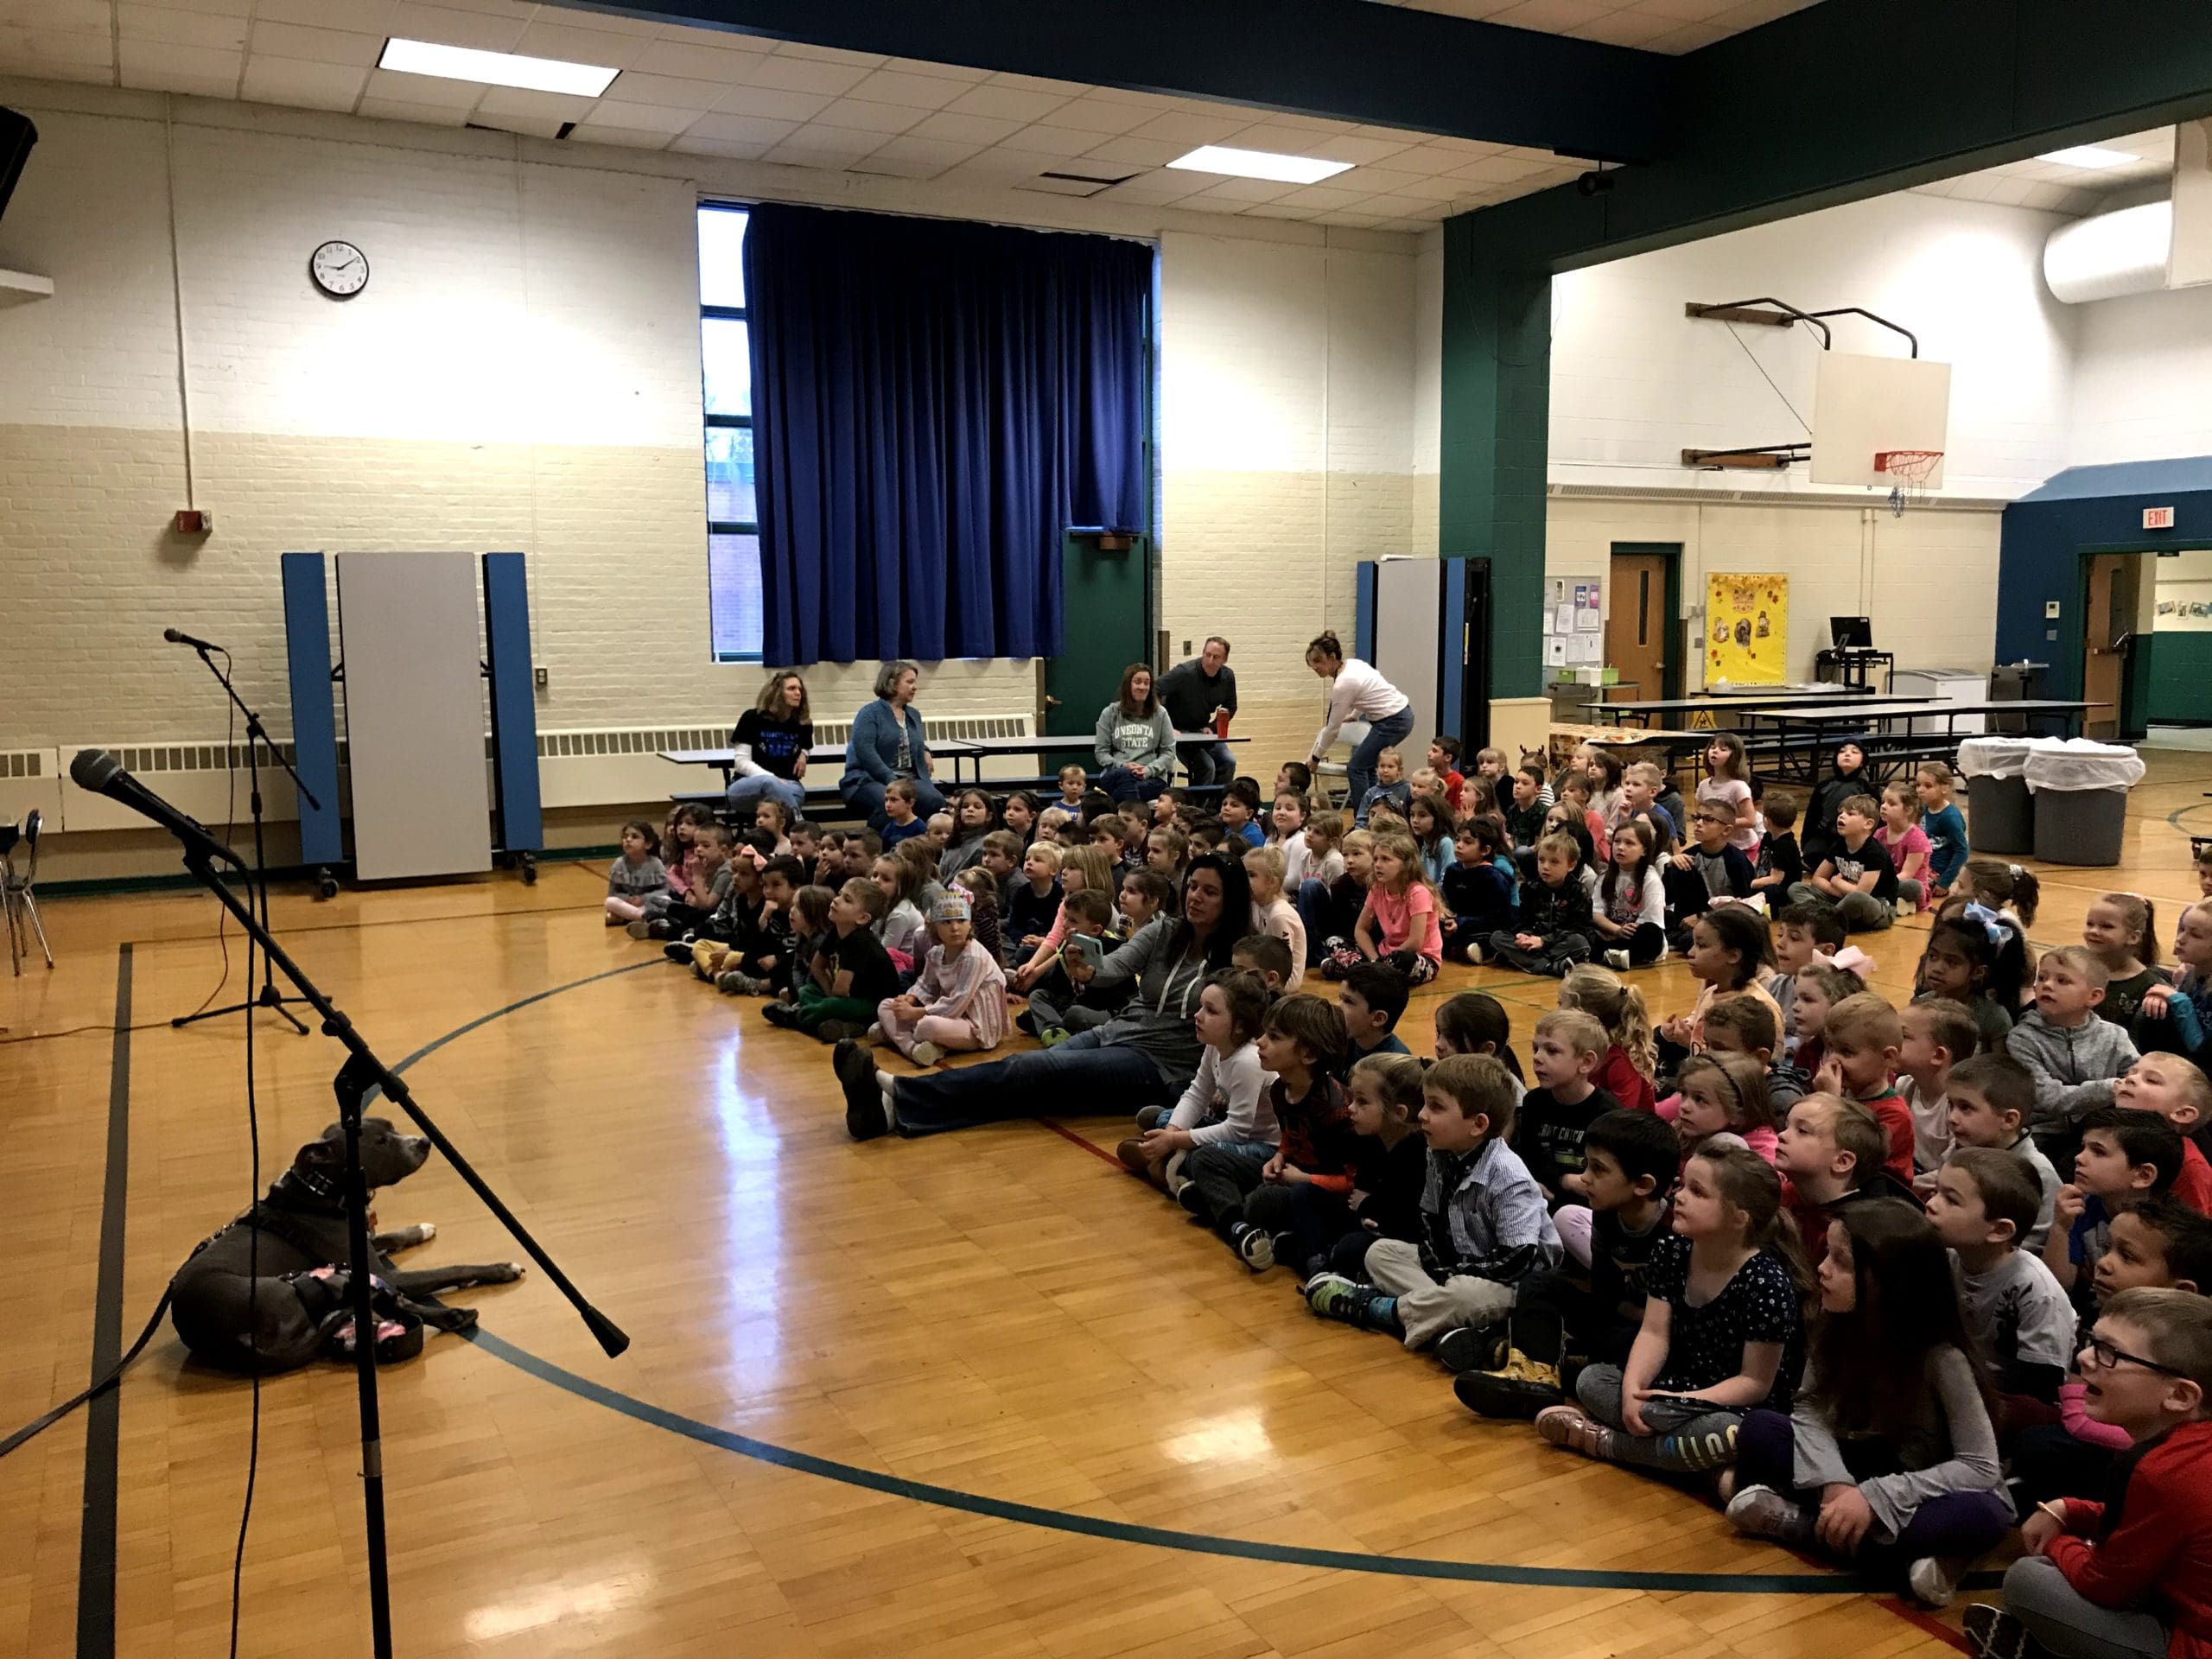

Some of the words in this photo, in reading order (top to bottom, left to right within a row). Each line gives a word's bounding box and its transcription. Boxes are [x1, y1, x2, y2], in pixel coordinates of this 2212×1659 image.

[2148, 510, 2168, 526] EXIT
[1115, 723, 1154, 739] ONEONTA
[1121, 737, 1148, 747] STATE
